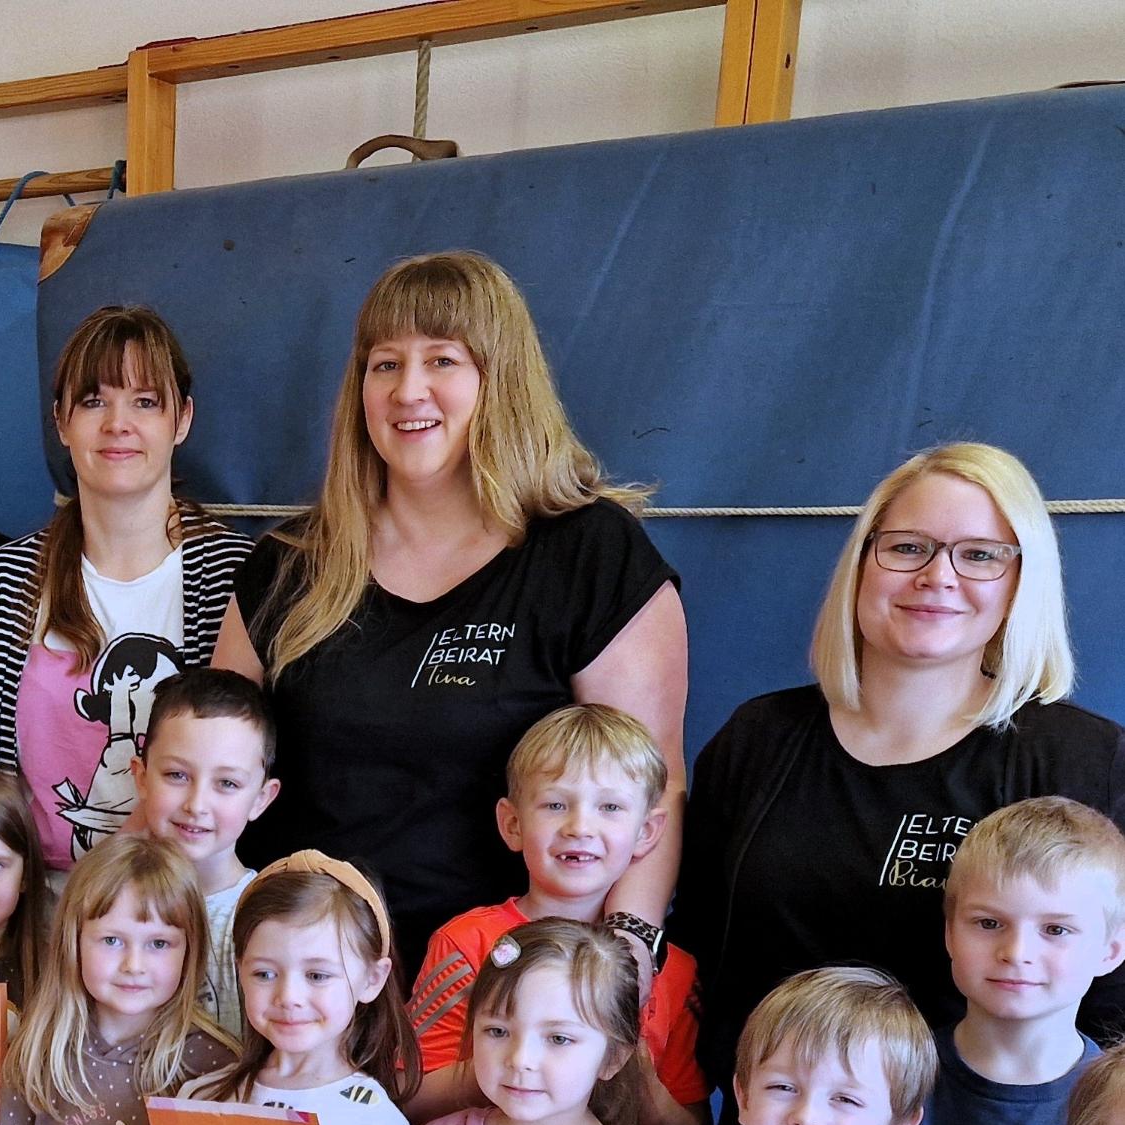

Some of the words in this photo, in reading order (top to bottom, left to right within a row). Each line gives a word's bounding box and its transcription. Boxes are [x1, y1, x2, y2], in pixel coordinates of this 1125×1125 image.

[438, 623, 516, 646] ELTERN
[427, 647, 506, 666] BEIRAT
[425, 663, 476, 686] Tina
[906, 814, 975, 837] ELTE
[897, 839, 957, 863] BEIR
